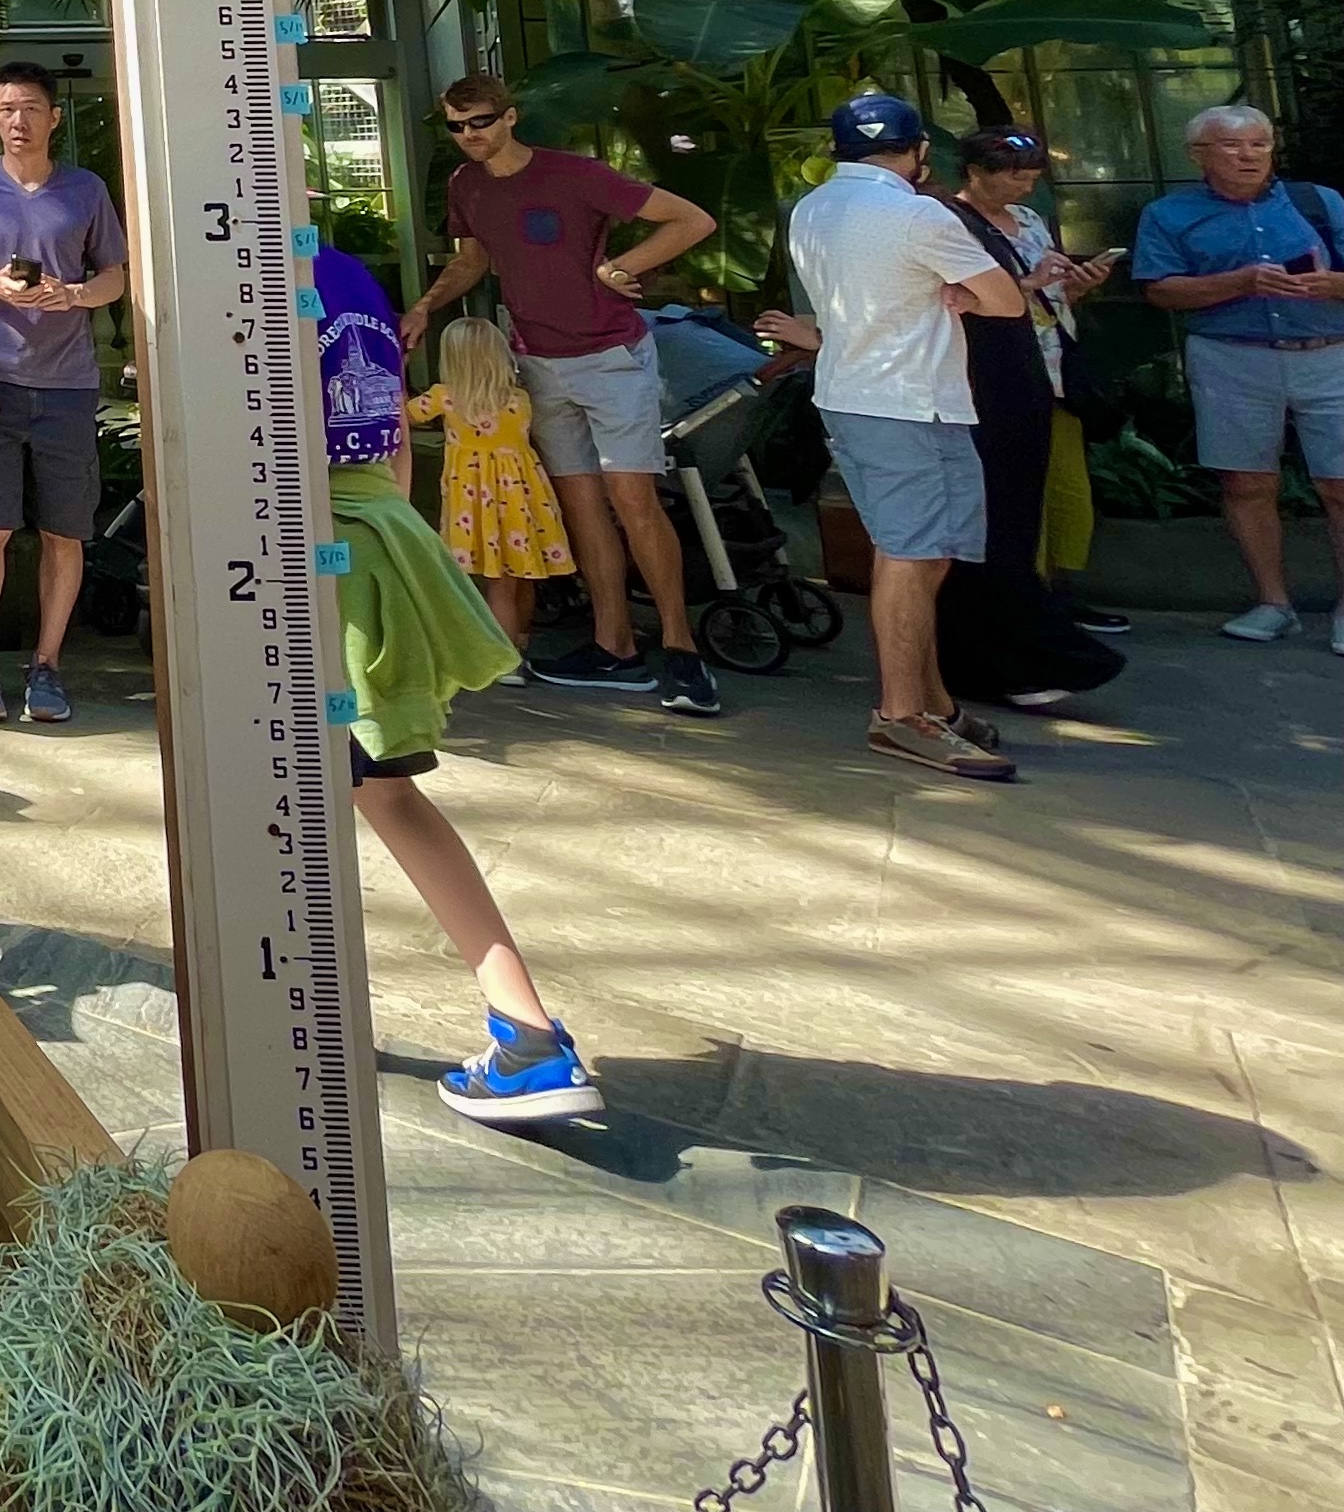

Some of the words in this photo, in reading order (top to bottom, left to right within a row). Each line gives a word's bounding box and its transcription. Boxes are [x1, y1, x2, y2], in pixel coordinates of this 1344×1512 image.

[219, 7, 232, 25] 6
[222, 40, 235, 59] 5
[225, 75, 238, 94] 4
[227, 109, 240, 128] 3
[230, 144, 243, 163] 2
[236, 178, 243, 197] 1
[204, 203, 230, 241] 3
[238, 248, 251, 268] 9
[240, 284, 253, 303] 8
[242, 319, 254, 339] 7
[245, 355, 258, 374] 6
[247, 390, 261, 410] 5
[250, 426, 264, 446] 4
[252, 463, 266, 483] 3
[255, 499, 269, 519] 2
[261, 535, 268, 555] 1
[228, 561, 255, 601] 2
[263, 609, 276, 629] 9
[265, 645, 279, 666] 8
[268, 683, 281, 703] 7
[270, 720, 284, 741] 6
[273, 757, 287, 778] 5
[276, 795, 290, 816] 4
[279, 834, 293, 854] 3
[281, 871, 296, 893] 2
[288, 910, 295, 931] 1
[261, 937, 276, 979] 1
[290, 988, 304, 1010] 9
[293, 1028, 307, 1050] 8
[296, 1067, 309, 1090] 7
[299, 1107, 314, 1130] 6
[302, 1147, 317, 1170] 5
